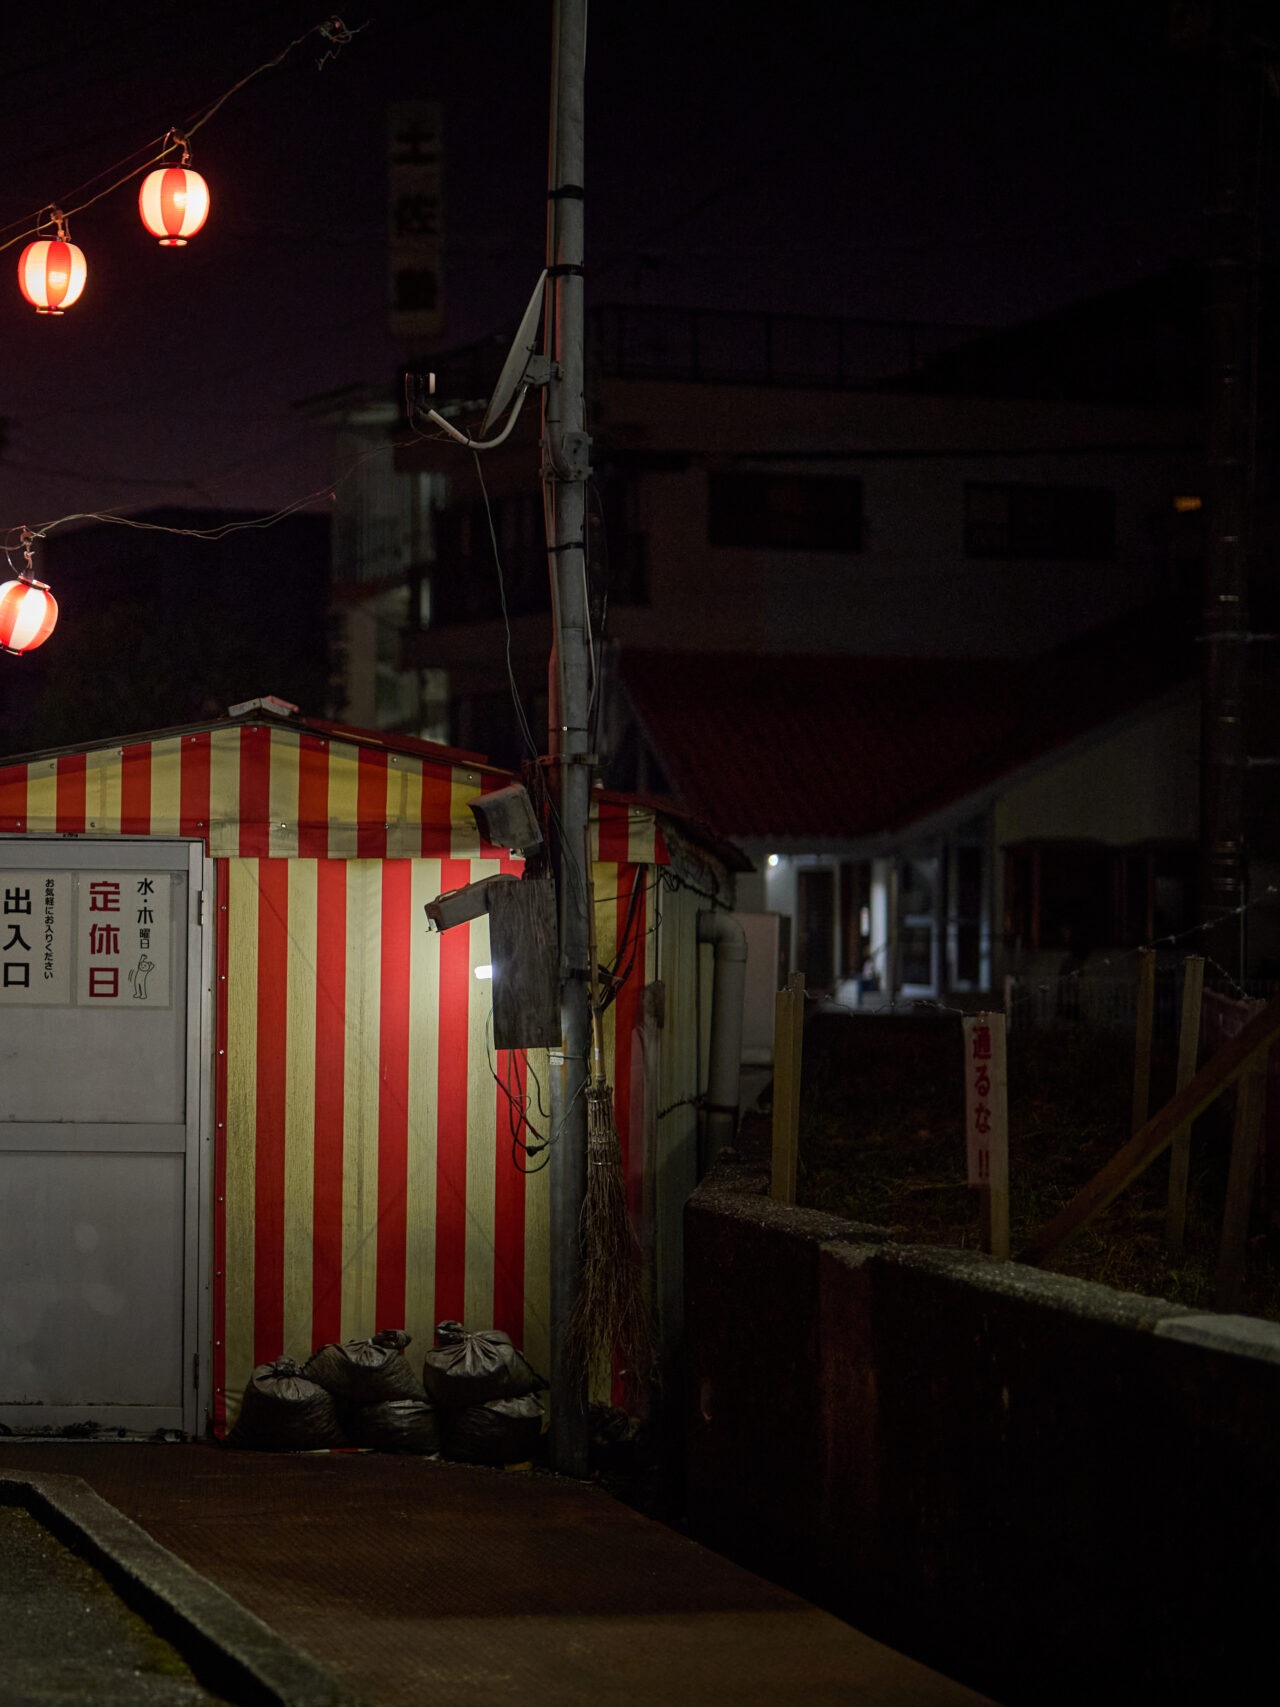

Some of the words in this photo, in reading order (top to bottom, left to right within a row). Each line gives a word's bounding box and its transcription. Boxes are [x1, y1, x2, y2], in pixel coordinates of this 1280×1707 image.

[2, 887, 32, 988] 出入口
[43, 879, 54, 980] お気軽にお入りください
[89, 880, 121, 998] 定休日
[137, 878, 154, 949] 水・木曜日
